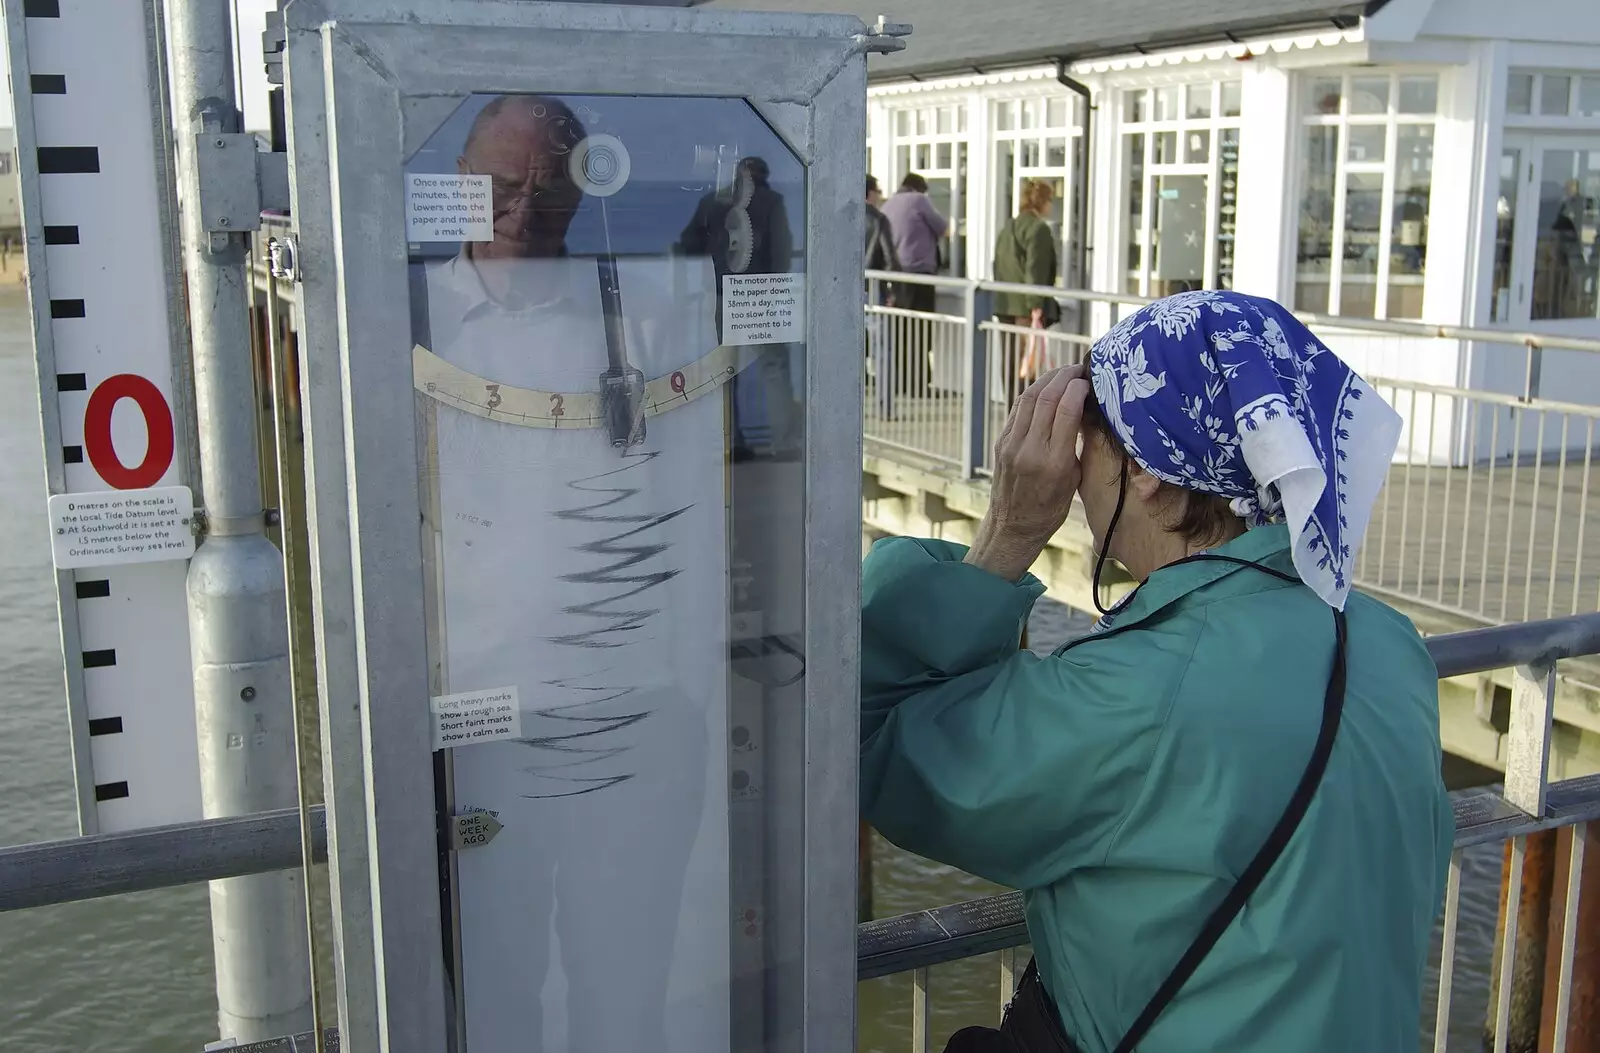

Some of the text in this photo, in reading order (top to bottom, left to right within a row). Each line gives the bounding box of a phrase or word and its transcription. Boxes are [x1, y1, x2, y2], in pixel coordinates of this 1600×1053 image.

[413, 178, 483, 188] Once every five
[452, 191, 467, 199] the
[469, 192, 486, 200] pen
[413, 202, 444, 211] lowers
[470, 203, 485, 211] the
[412, 216, 437, 226] paper
[729, 277, 743, 285] The
[744, 277, 768, 285] motor
[732, 287, 790, 297] the paper down
[746, 310, 764, 318] slow
[766, 309, 777, 317] for
[731, 321, 770, 330] movement
[485, 370, 685, 416] 3 2 0
[83, 373, 175, 490] 0
[77, 502, 109, 510] metres
[125, 499, 140, 507] the
[142, 497, 164, 506] scale
[167, 496, 174, 504] is
[62, 515, 77, 523] the
[80, 513, 101, 522] local
[104, 511, 123, 520] Tide
[126, 509, 155, 518] Datum
[67, 526, 79, 535] At
[81, 522, 129, 533] Southwold
[131, 521, 138, 529] it
[166, 519, 175, 527] at
[91, 535, 123, 544] metres
[125, 532, 151, 540] below
[154, 531, 169, 539] the
[69, 546, 115, 556] Ordinance
[117, 544, 144, 553] Survey
[439, 693, 512, 709] Long heavy marks
[440, 710, 461, 720] show
[471, 706, 494, 716] rough
[440, 715, 513, 731] Short faint marks
[442, 733, 464, 742] show
[473, 728, 493, 737] calm
[460, 816, 480, 826] ONE
[459, 823, 489, 836] WEEK
[463, 833, 485, 845] AGO
